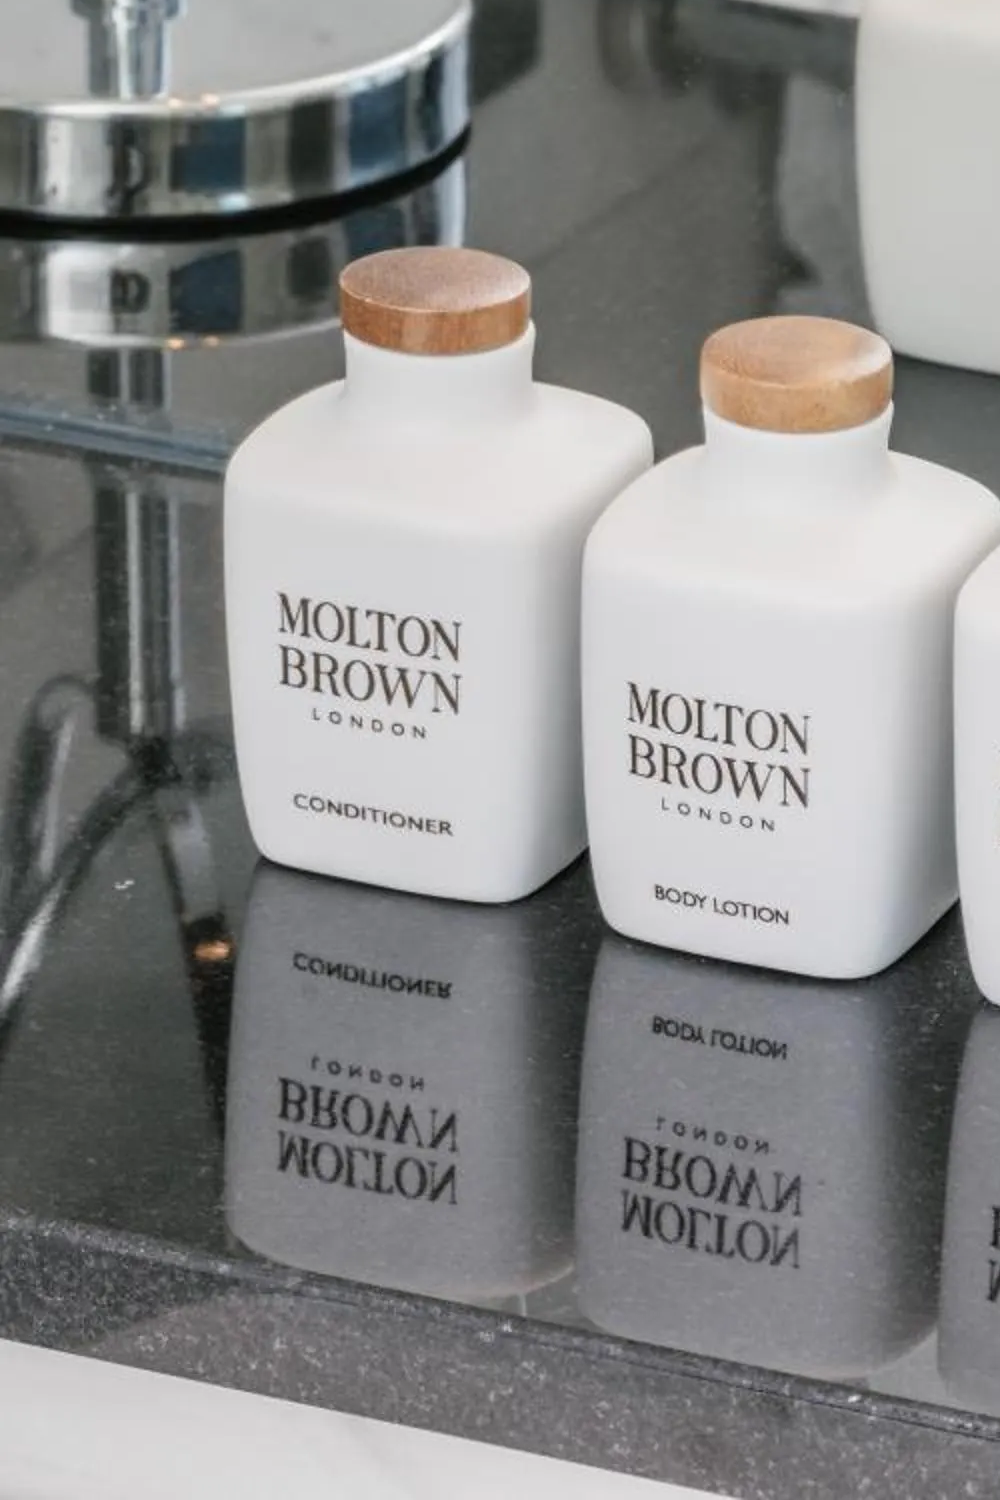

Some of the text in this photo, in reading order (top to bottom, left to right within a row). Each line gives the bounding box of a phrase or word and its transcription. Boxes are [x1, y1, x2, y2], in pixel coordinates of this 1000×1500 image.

[277, 592, 461, 661] MOLTON
[280, 645, 461, 714] BROWN
[312, 709, 427, 739] LONDON
[627, 682, 809, 754] MOLTON
[629, 736, 809, 808] BROWN
[293, 794, 453, 836] CONDITIONER
[661, 799, 774, 831] LONDON
[654, 884, 789, 925] BODY LOTION
